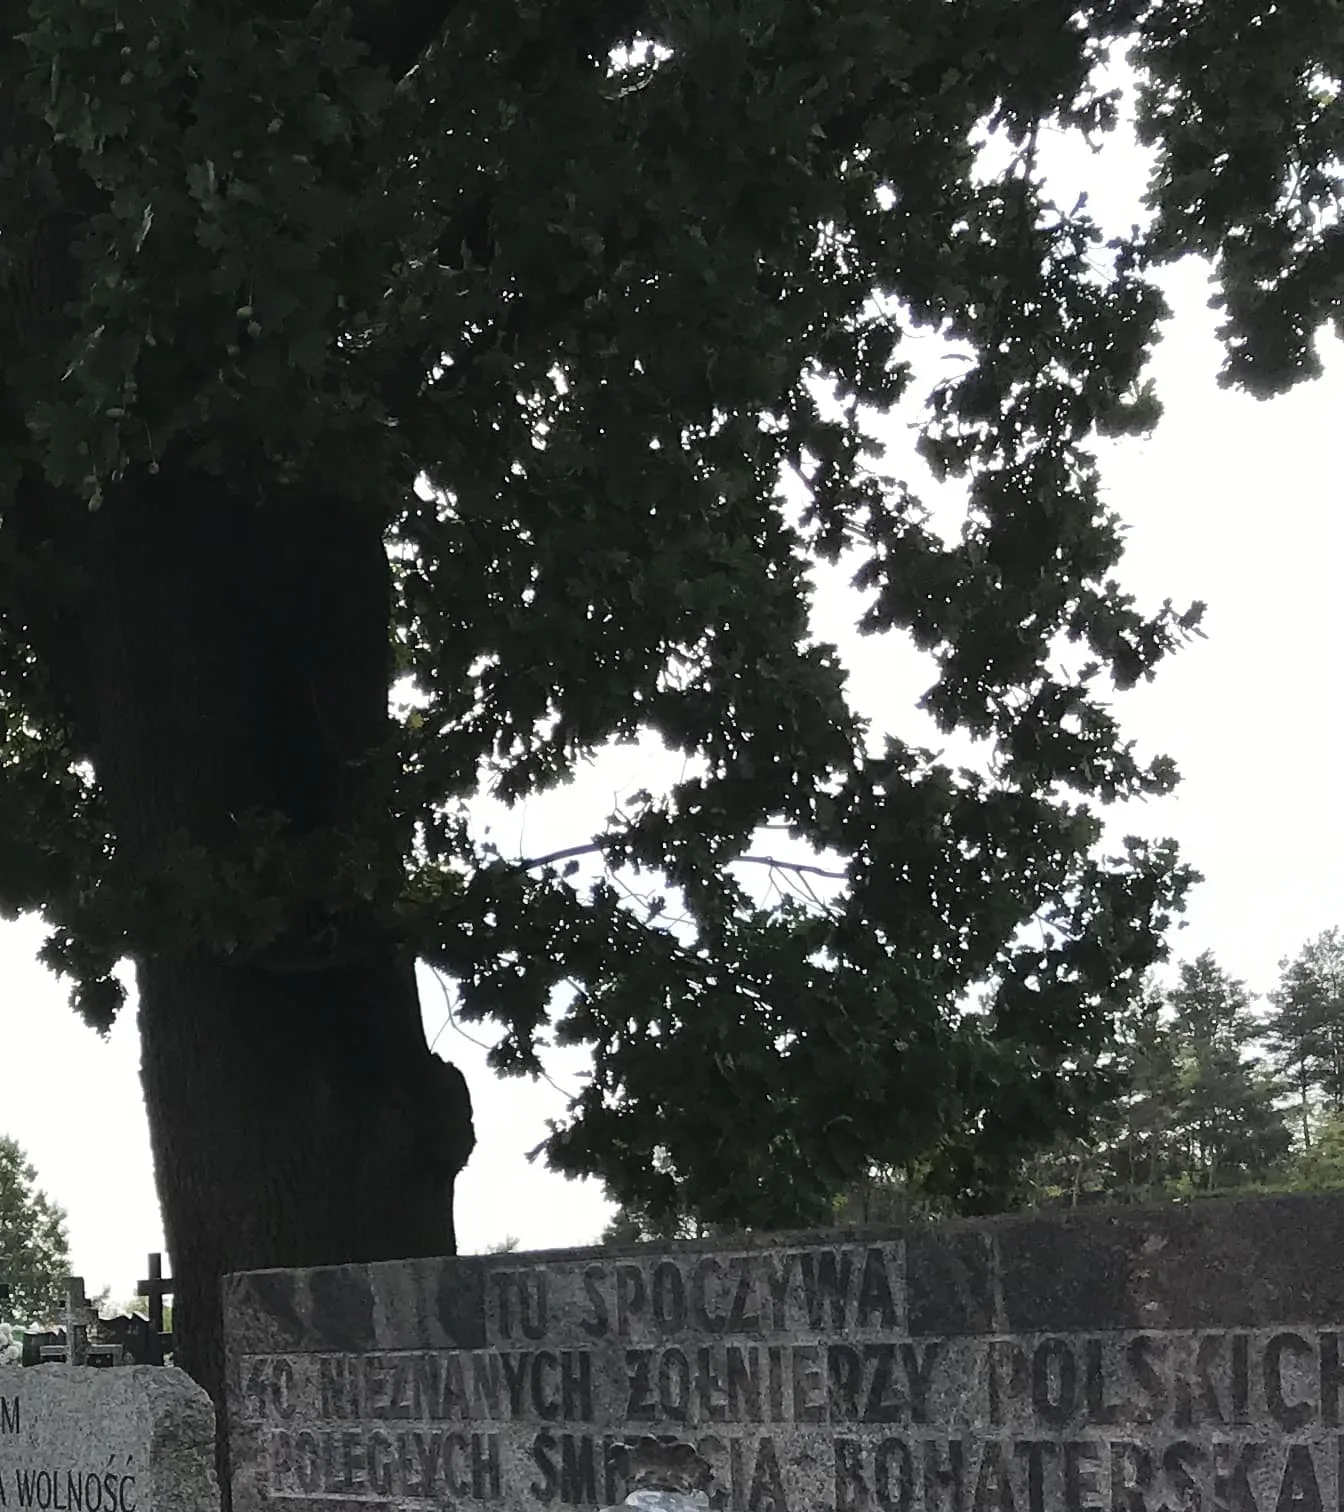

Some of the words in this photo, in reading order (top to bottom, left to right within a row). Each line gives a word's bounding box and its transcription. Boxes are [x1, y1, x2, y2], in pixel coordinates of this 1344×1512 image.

[490, 1270, 548, 1340] TU
[580, 1246, 897, 1338] SPOCZYWA
[319, 1347, 593, 1422] NIEZNANYCH
